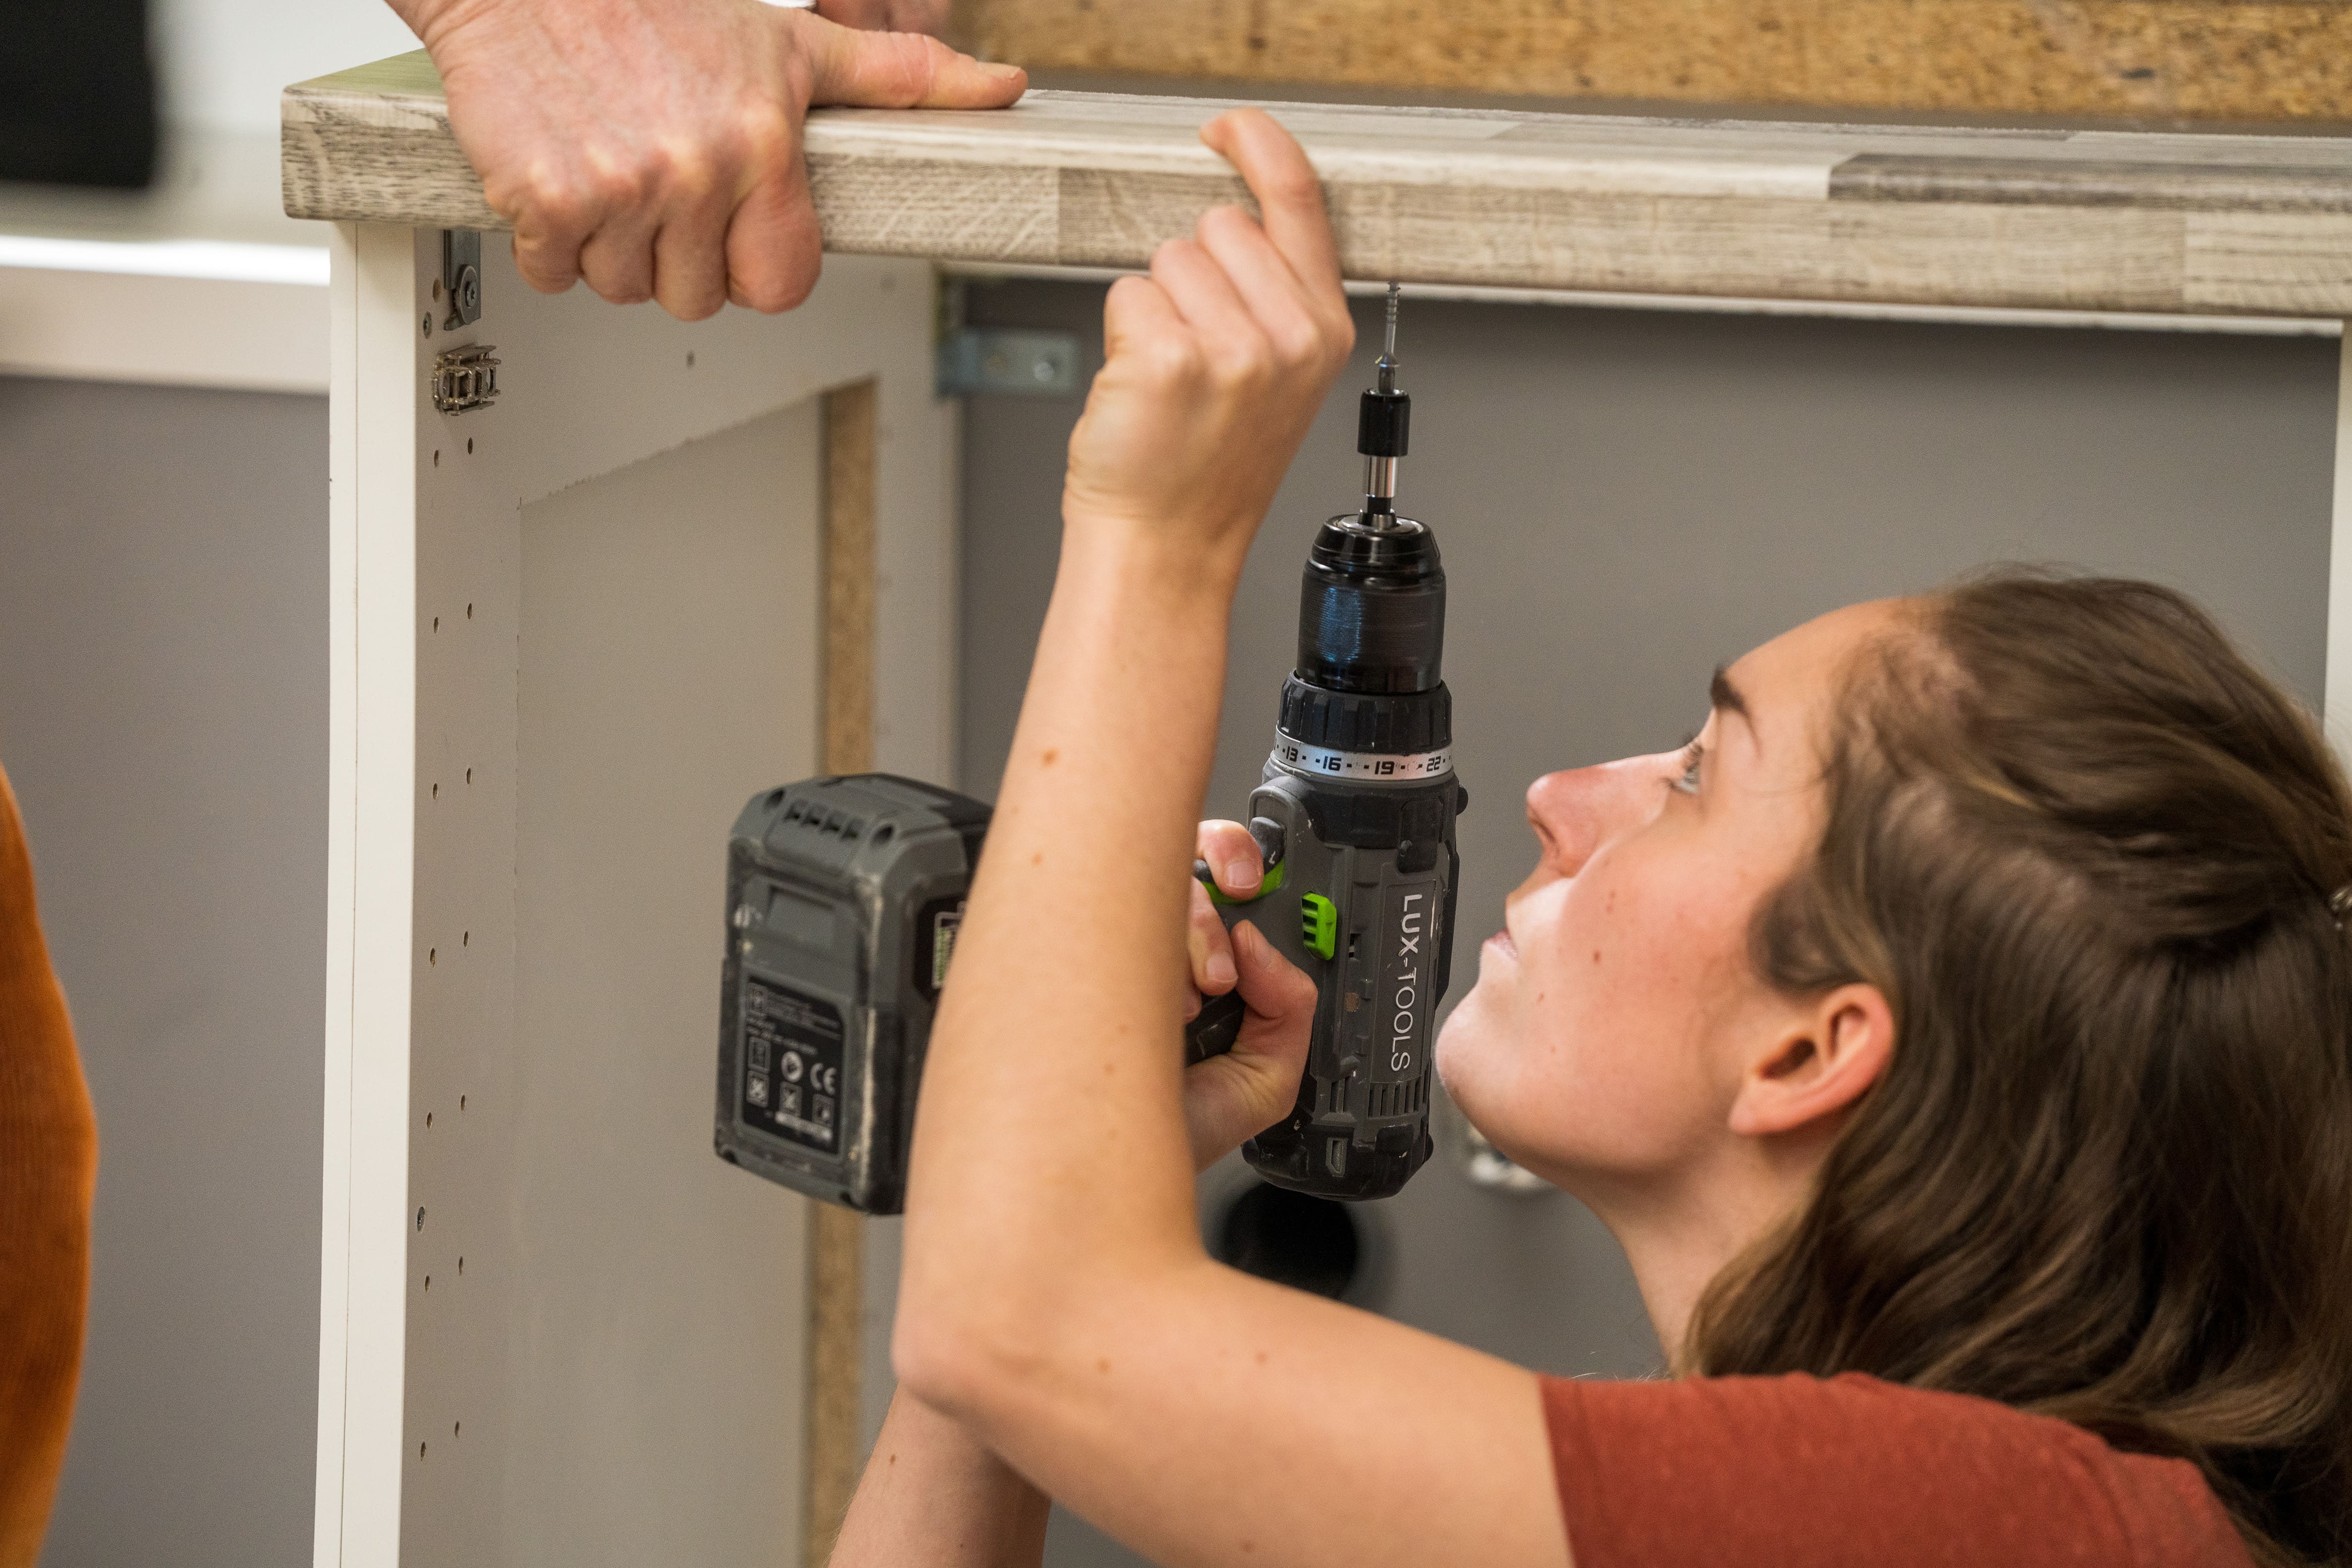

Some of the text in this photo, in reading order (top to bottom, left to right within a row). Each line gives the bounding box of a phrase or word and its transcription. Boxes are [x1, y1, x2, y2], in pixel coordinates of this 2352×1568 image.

[1286, 745, 1441, 775] 13 16 19 22
[1391, 894, 1422, 1072] LUX-TOOLS
[810, 1062, 837, 1095] CE
